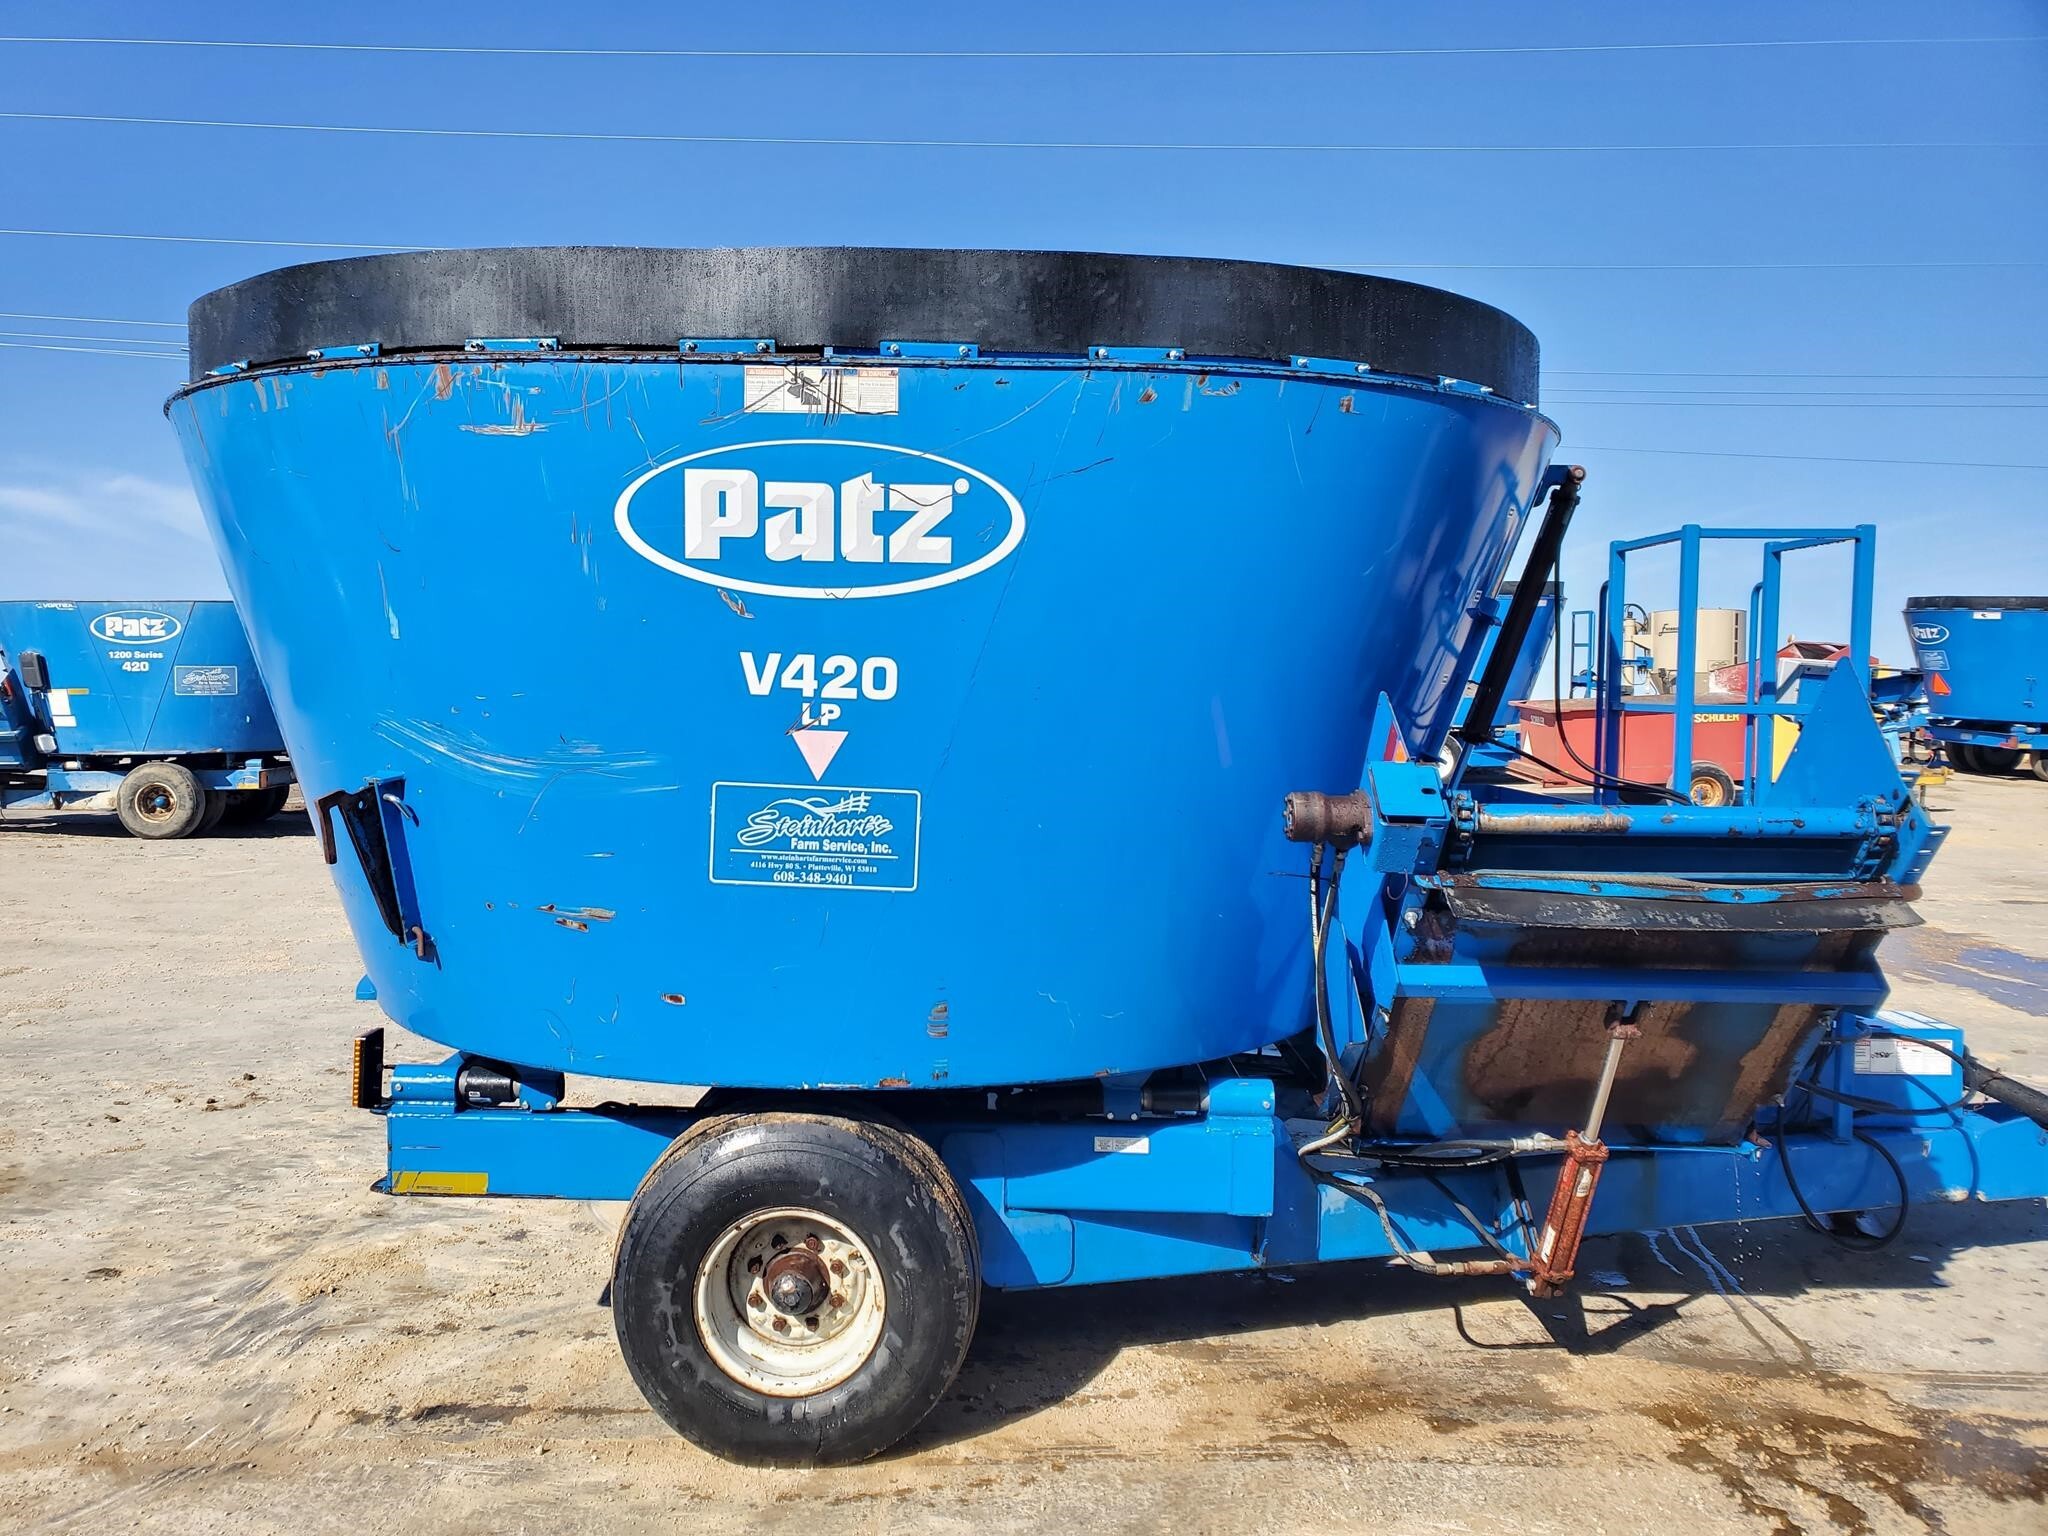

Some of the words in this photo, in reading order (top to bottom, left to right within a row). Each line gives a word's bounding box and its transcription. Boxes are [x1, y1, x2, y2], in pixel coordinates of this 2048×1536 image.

[684, 468, 953, 564] Patz
[105, 616, 165, 637] Patz
[109, 651, 132, 659] 1200
[134, 651, 163, 659] Series
[122, 661, 149, 672] 420
[739, 651, 898, 701] V420
[801, 702, 841, 726] LP
[1693, 713, 1740, 723] SCHULER
[737, 809, 893, 846] Steinhart's
[791, 837, 819, 851] Farm
[822, 839, 868, 854] Service,
[871, 841, 892, 854] Inc.
[751, 861, 766, 869] 4116
[768, 862, 783, 871] Hwy
[773, 871, 853, 885] 608-348-9401
